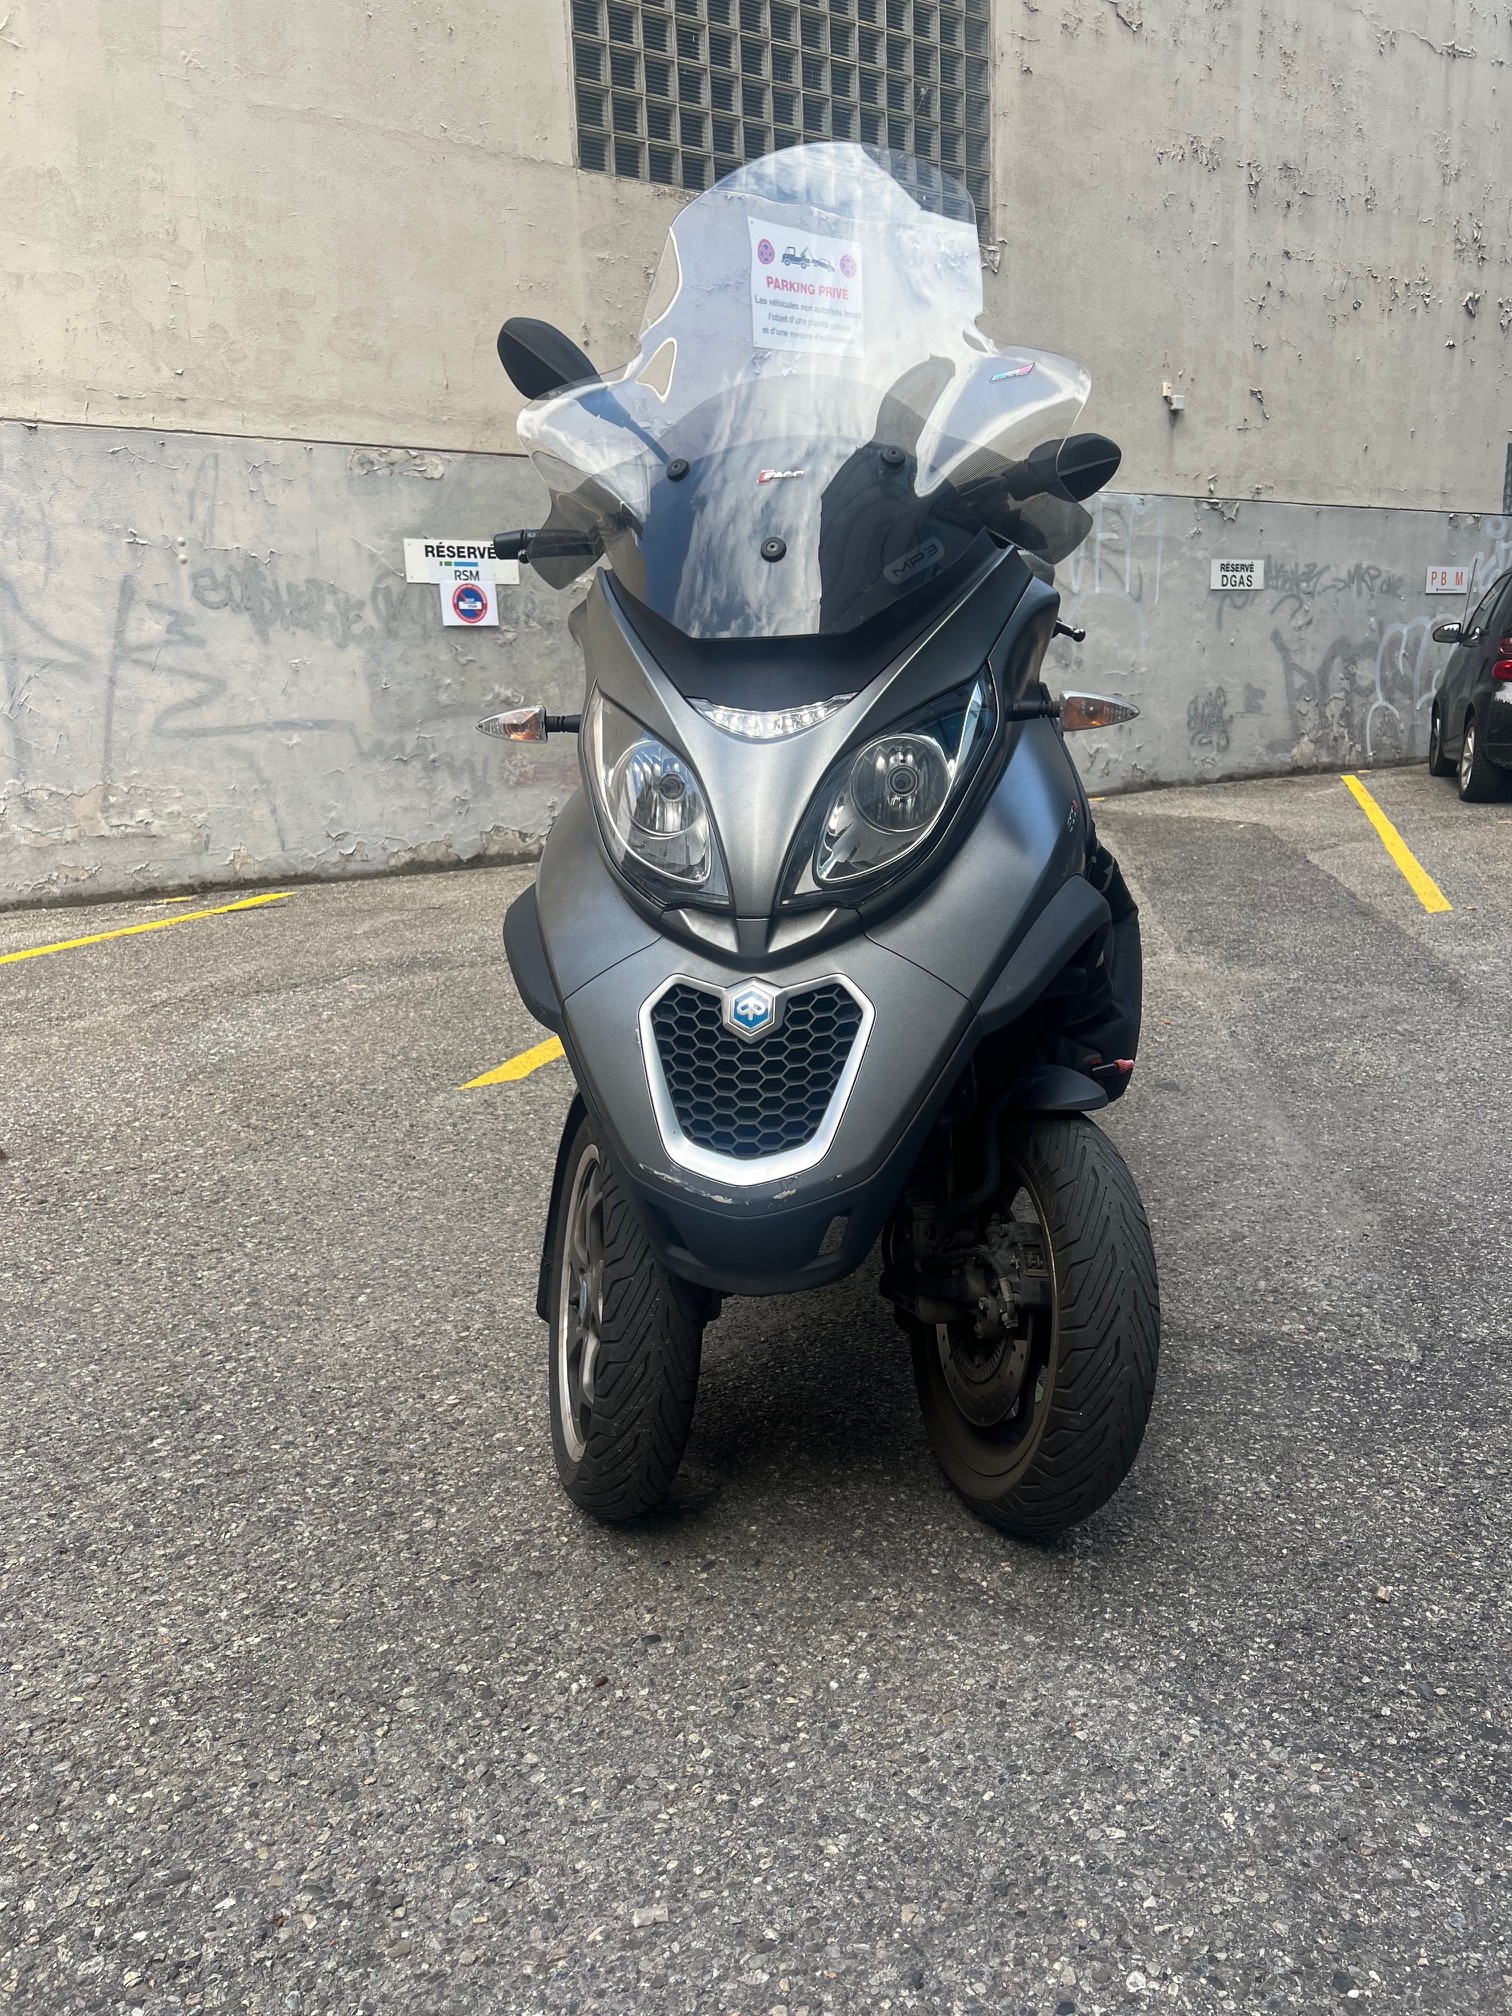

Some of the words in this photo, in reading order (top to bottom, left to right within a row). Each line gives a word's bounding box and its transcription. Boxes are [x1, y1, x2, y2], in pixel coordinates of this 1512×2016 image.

[766, 276, 815, 295] PARKING
[818, 285, 849, 300] PRIVÉ
[754, 295, 768, 305] Les
[769, 297, 799, 310] véhicules
[768, 312, 788, 324] l'objet
[762, 327, 770, 335] et
[771, 328, 788, 337] d'une
[424, 541, 497, 559] RÉSERVÉ
[891, 544, 938, 577] MP3
[1220, 561, 1255, 573] RÉSERVÉ
[454, 569, 480, 581] RSM
[1221, 574, 1253, 587] DGAS
